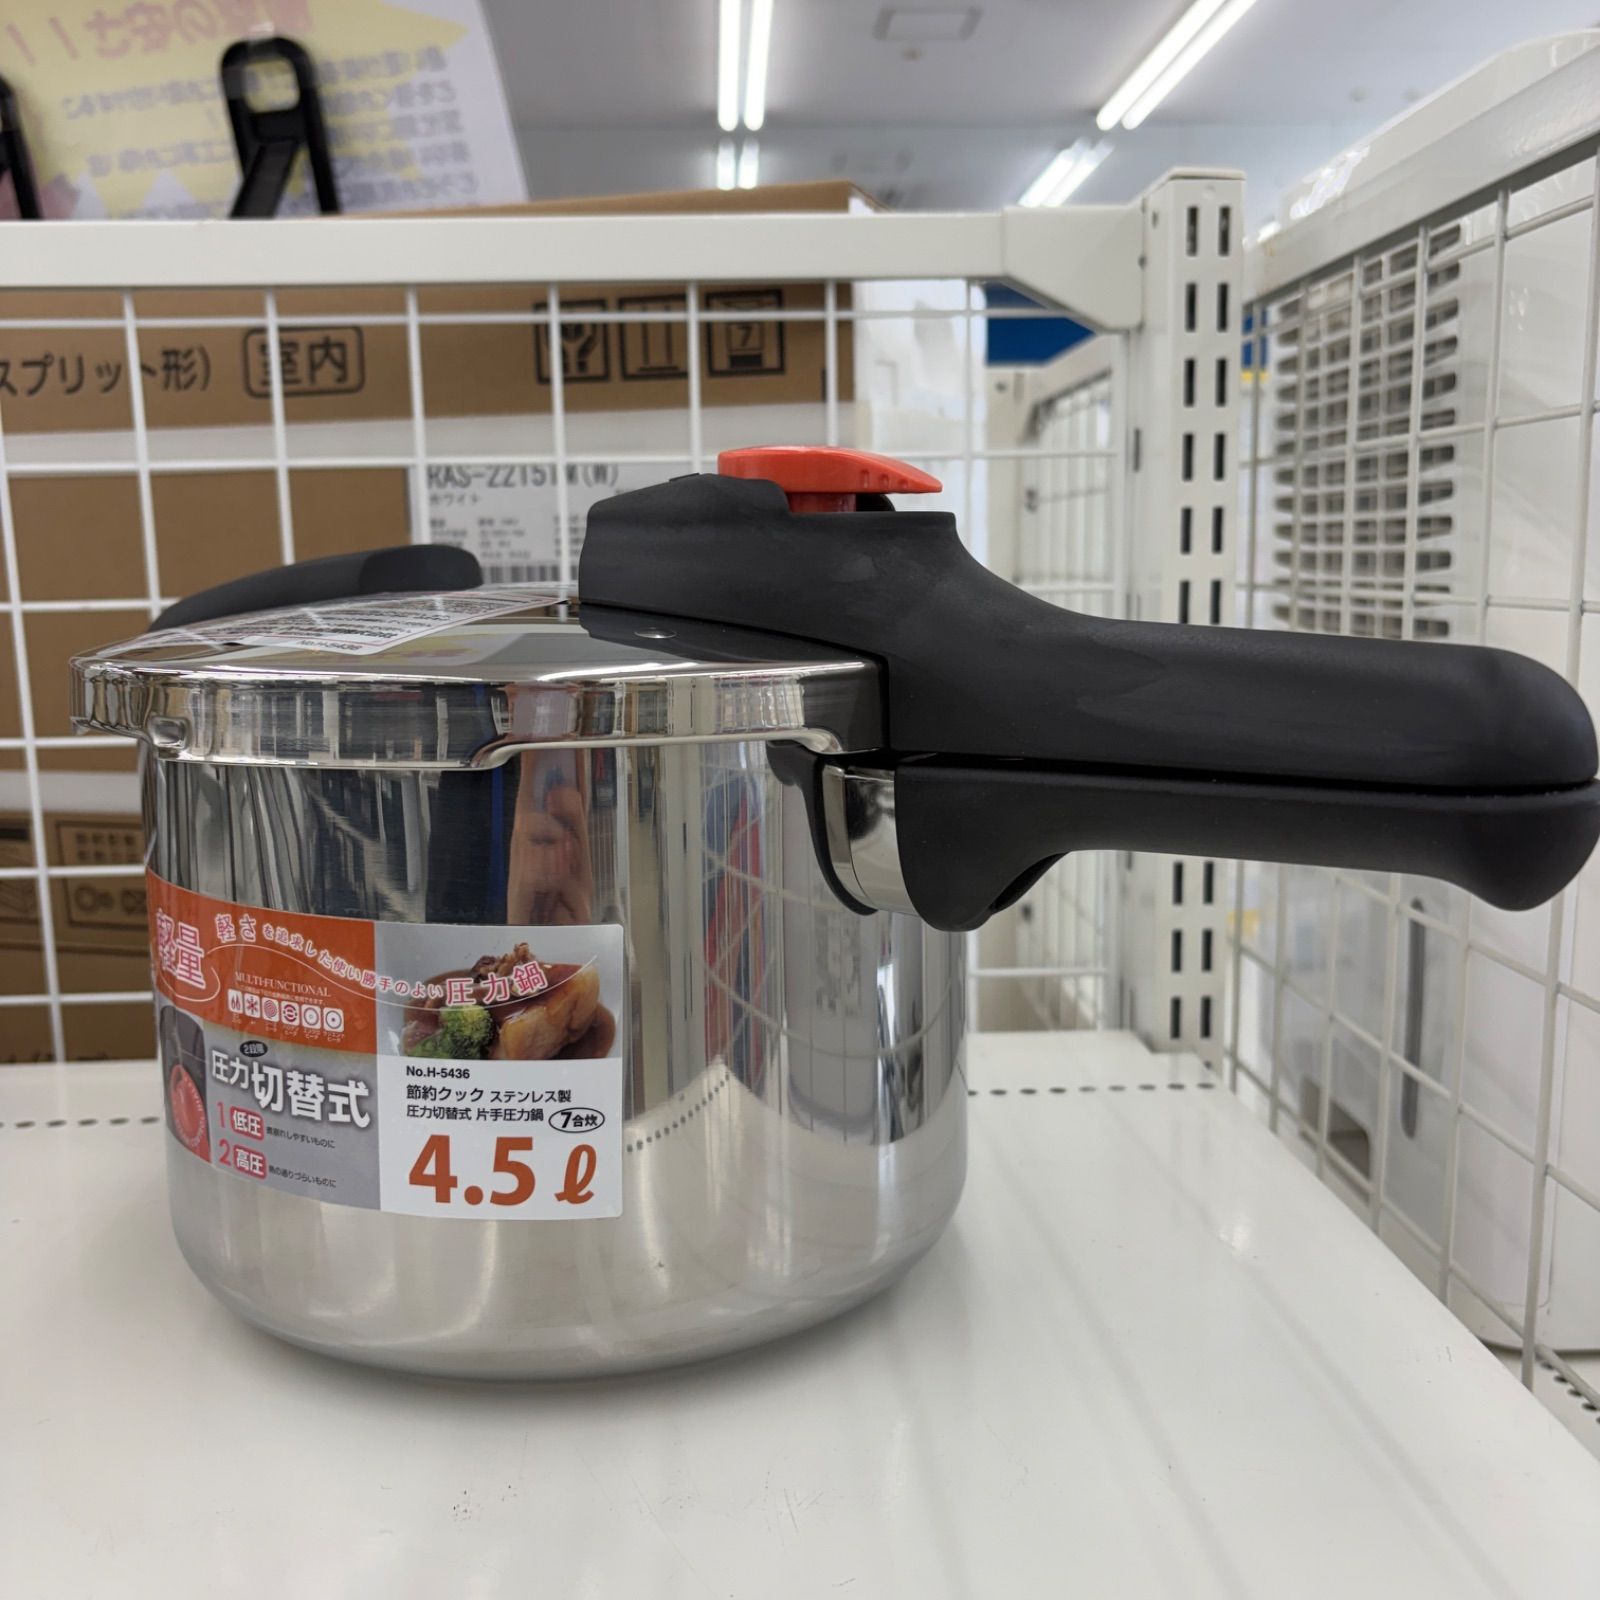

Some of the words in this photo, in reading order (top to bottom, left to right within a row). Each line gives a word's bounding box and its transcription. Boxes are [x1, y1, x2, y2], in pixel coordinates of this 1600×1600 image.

[155, 908, 207, 990] 軽量
[234, 970, 332, 998] MULTI-FUNCTIONAL
[406, 1065, 471, 1079] No.H-5436
[211, 1050, 371, 1128] 圧力切替式
[406, 1085, 485, 1102] 節約クック
[490, 1088, 572, 1104] ステンレス製
[232, 1109, 263, 1137] 低圧
[406, 1106, 472, 1121] 圧力切替式
[476, 1107, 544, 1122] 片手圧力鍋
[560, 1111, 598, 1129] 7合炊
[235, 1148, 265, 1175] 高圧
[408, 1134, 536, 1206] 4.5
